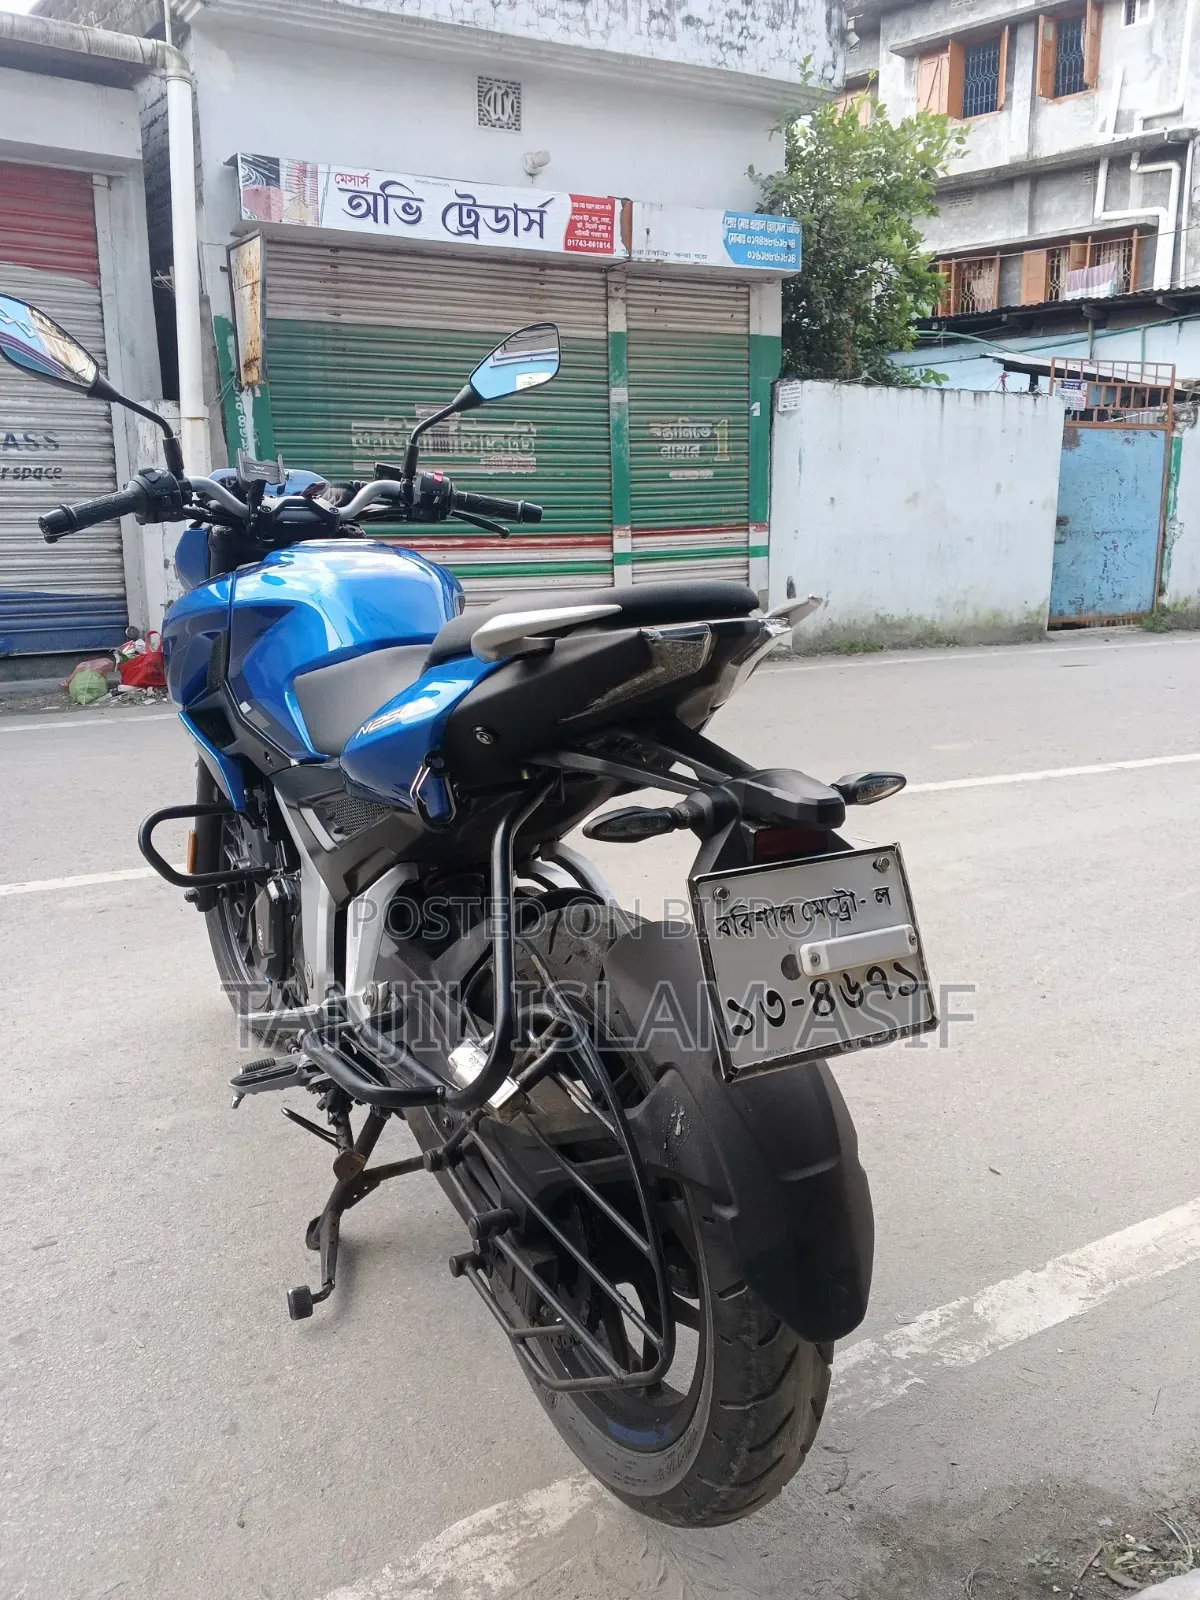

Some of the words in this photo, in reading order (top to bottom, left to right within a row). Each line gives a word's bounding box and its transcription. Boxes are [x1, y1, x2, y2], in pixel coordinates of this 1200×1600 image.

[334, 172, 371, 189] মেসার্স
[337, 179, 425, 226] অভি
[441, 188, 555, 240] ট্রেডার্স
[12, 467, 63, 481] space
[715, 904, 796, 937] বরিশাল
[873, 886, 892, 906] ল
[726, 961, 920, 1037] ১৩-৪৬৭১
